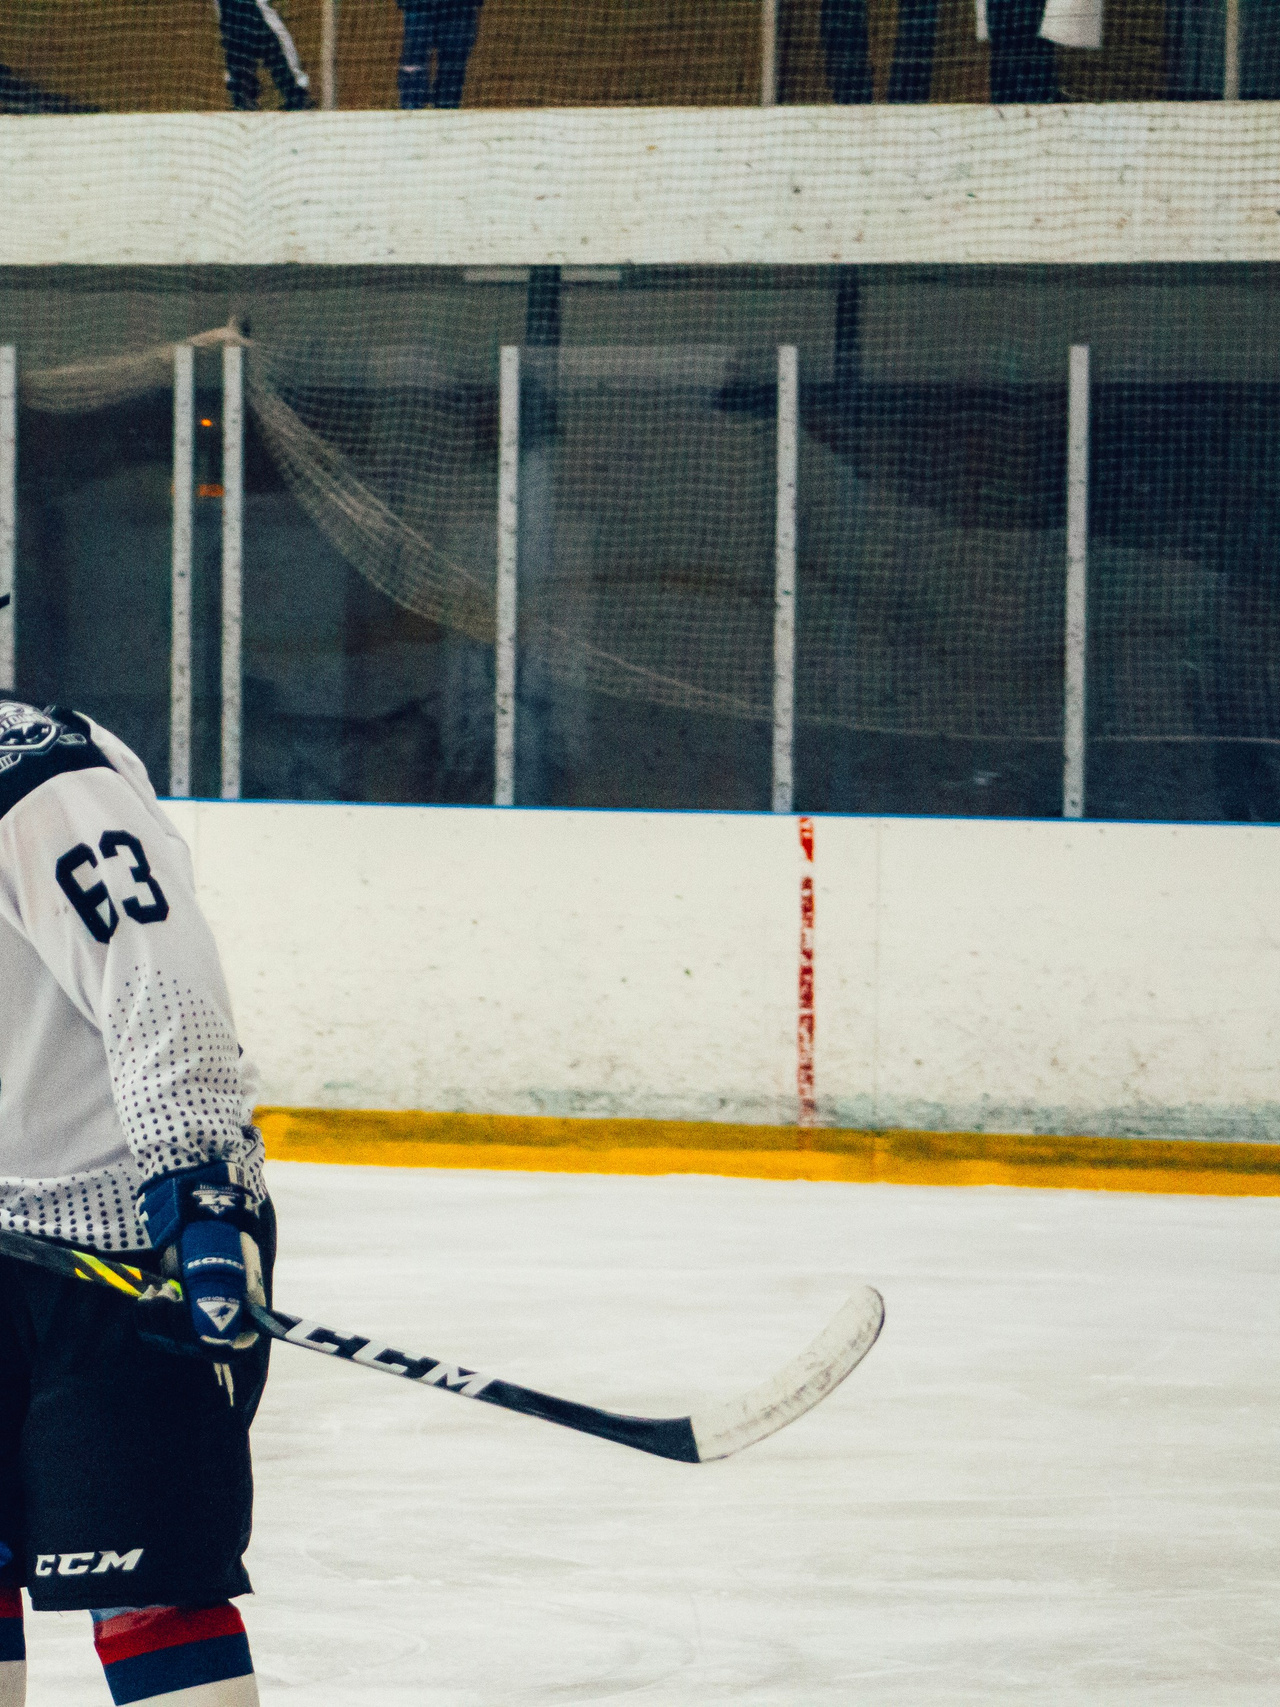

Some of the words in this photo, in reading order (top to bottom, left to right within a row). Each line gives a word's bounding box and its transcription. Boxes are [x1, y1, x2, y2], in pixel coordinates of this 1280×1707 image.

[55, 829, 169, 944] 63
[285, 1318, 497, 1399] CCM
[35, 1548, 144, 1576] CCM
